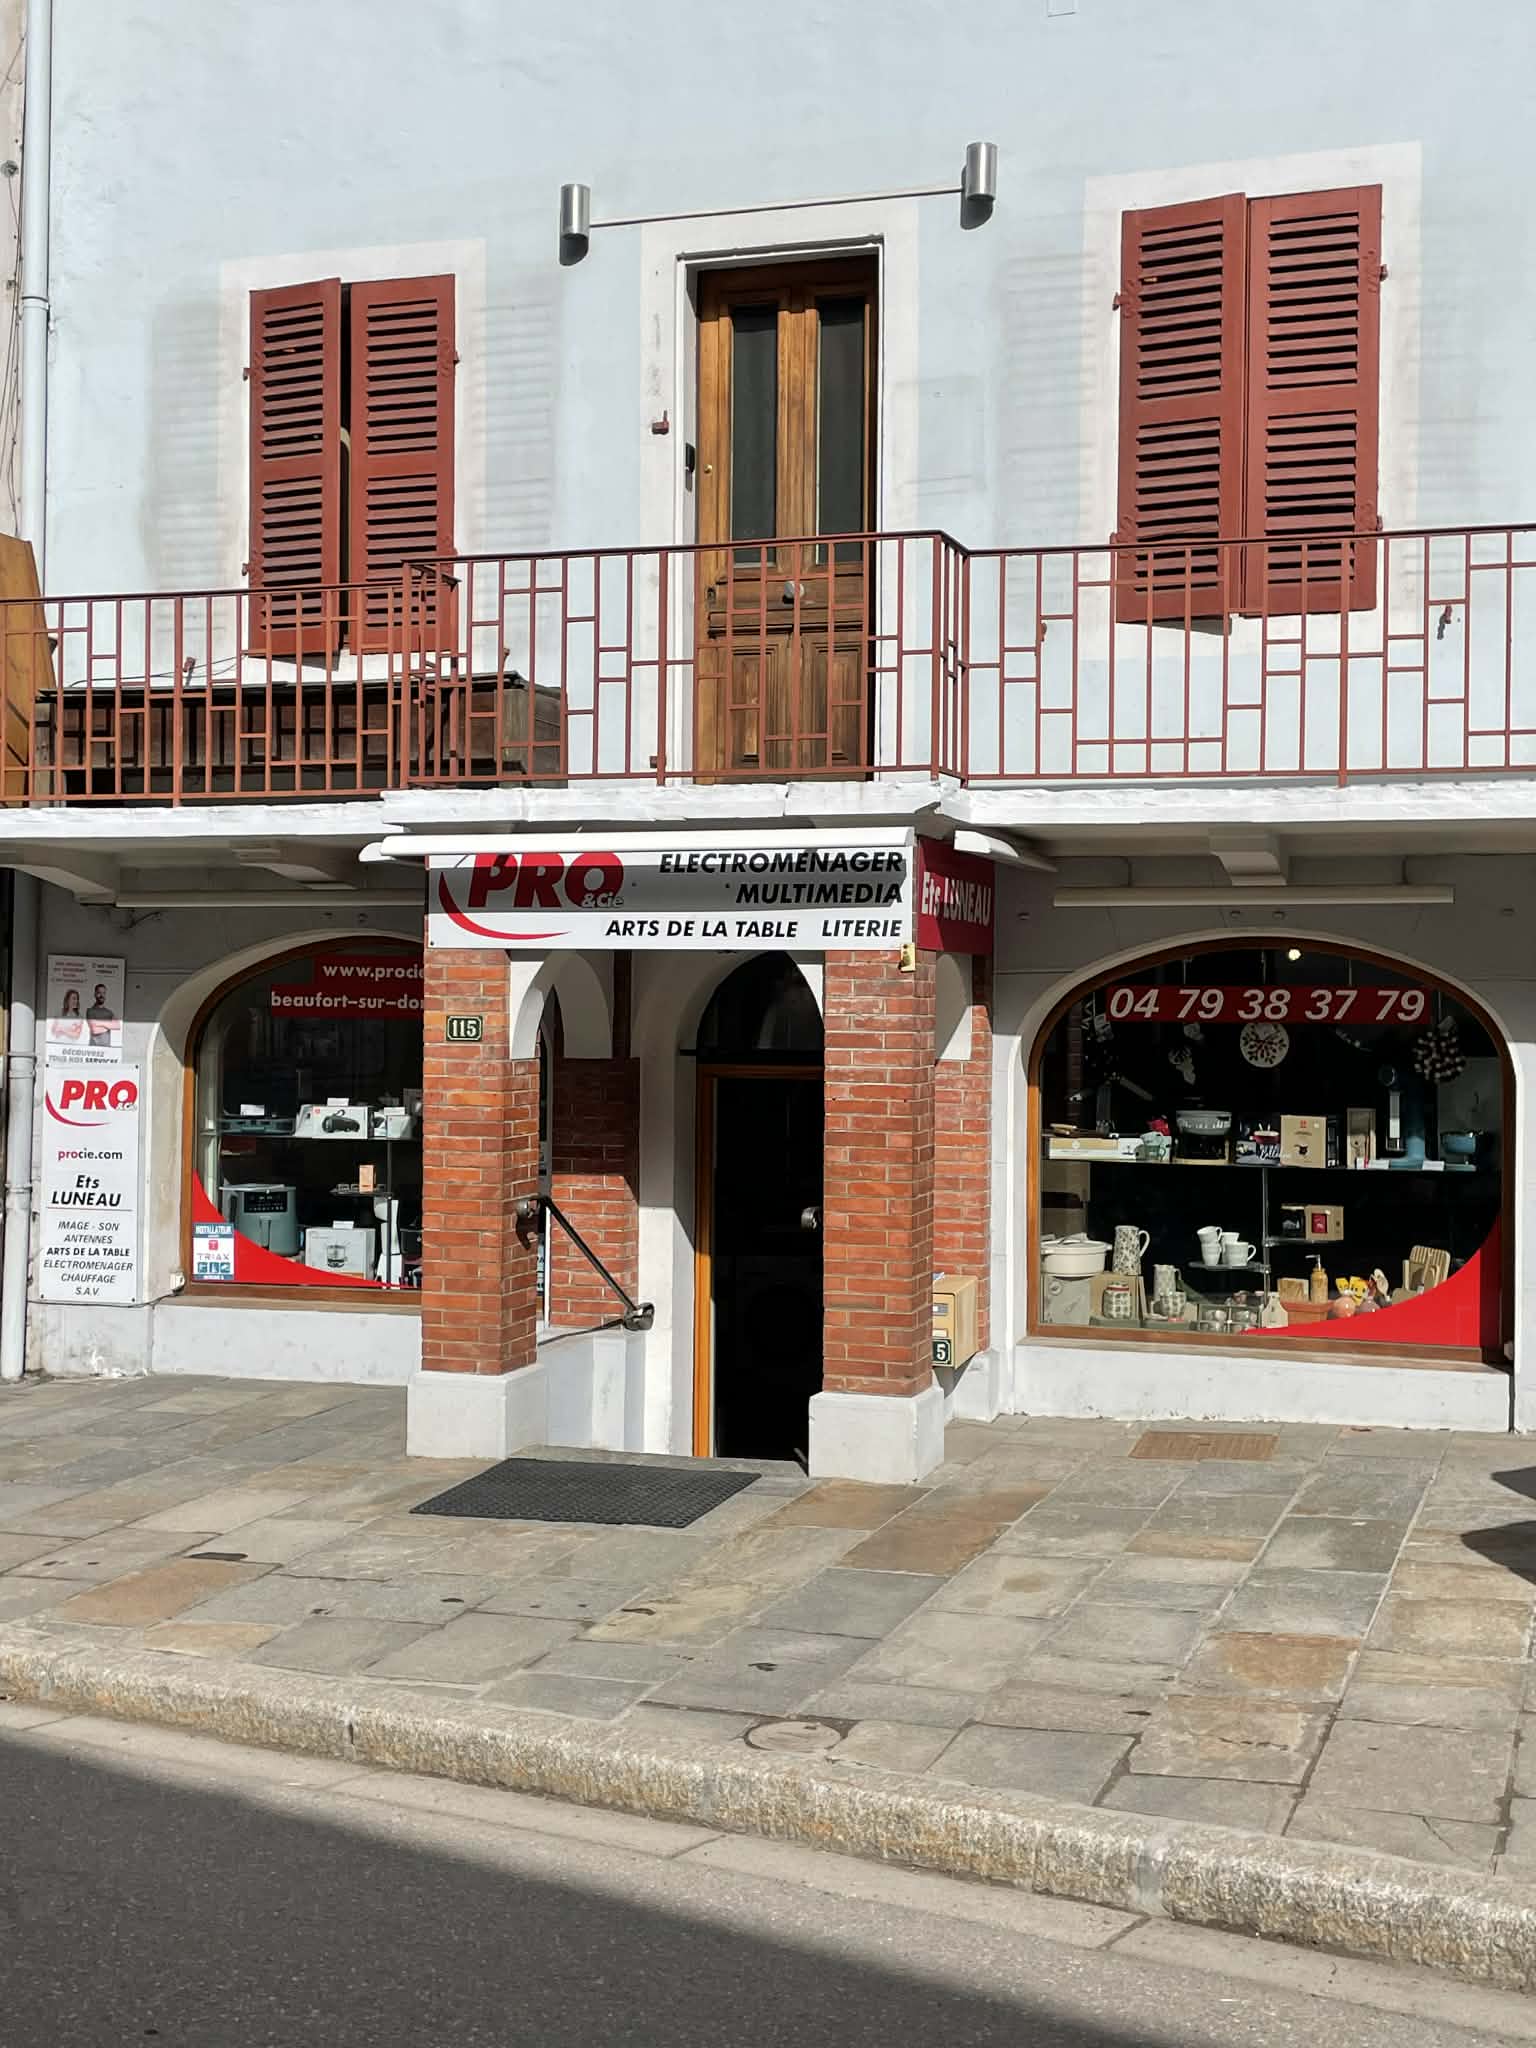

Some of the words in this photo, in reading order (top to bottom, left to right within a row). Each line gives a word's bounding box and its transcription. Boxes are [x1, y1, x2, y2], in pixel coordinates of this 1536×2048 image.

[660, 852, 903, 873] ELECTROMENAGER
[468, 852, 624, 908] PRO
[581, 893, 624, 908] &Cie
[736, 883, 903, 904] MULTIMEDIA
[921, 871, 941, 916] Ets
[944, 877, 991, 926] LUNEAU
[605, 919, 660, 937] ARTS
[667, 919, 695, 937] DE
[701, 920, 728, 937] LA
[735, 920, 798, 938] TABLE
[821, 919, 902, 937] LITERIE
[271, 991, 424, 1009] beaufort-sur-do
[1110, 987, 1160, 1019] 04
[1176, 989, 1224, 1019] 79
[1237, 989, 1291, 1020] 38
[1304, 989, 1357, 1020] 37
[1375, 990, 1425, 1022] 79
[452, 1019, 477, 1037] 115
[59, 1080, 138, 1110] PRO
[58, 1147, 123, 1161] procie.com
[75, 1174, 100, 1189] Ets
[51, 1191, 122, 1207] LUNEAU
[58, 1221, 90, 1231] IMAGE
[98, 1222, 120, 1231] SON
[64, 1234, 113, 1244] ANTENNES
[46, 1247, 71, 1256] ARTS
[73, 1247, 85, 1256] DE
[88, 1248, 100, 1256] LA
[102, 1248, 130, 1257] TABLE
[43, 1259, 134, 1271] ELECTROMENAGER
[61, 1273, 117, 1284] CHAUFFAGE
